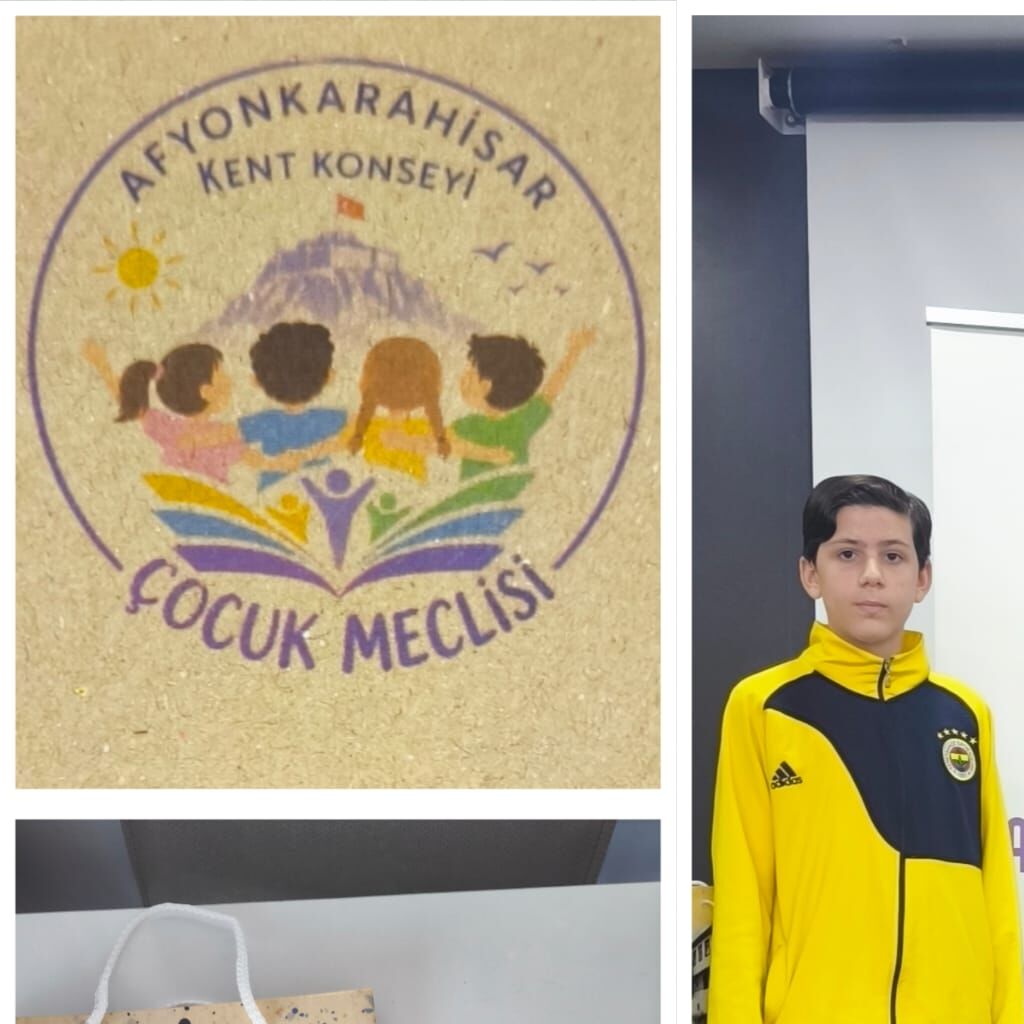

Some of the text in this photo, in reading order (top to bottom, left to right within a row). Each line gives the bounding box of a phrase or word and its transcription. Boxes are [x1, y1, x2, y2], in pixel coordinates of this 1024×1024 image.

[119, 81, 558, 210] AFYONKARAHİSAR
[199, 151, 478, 200] KENT KONSEYİ
[125, 553, 556, 674] ÇOCUK MECLİSİ
